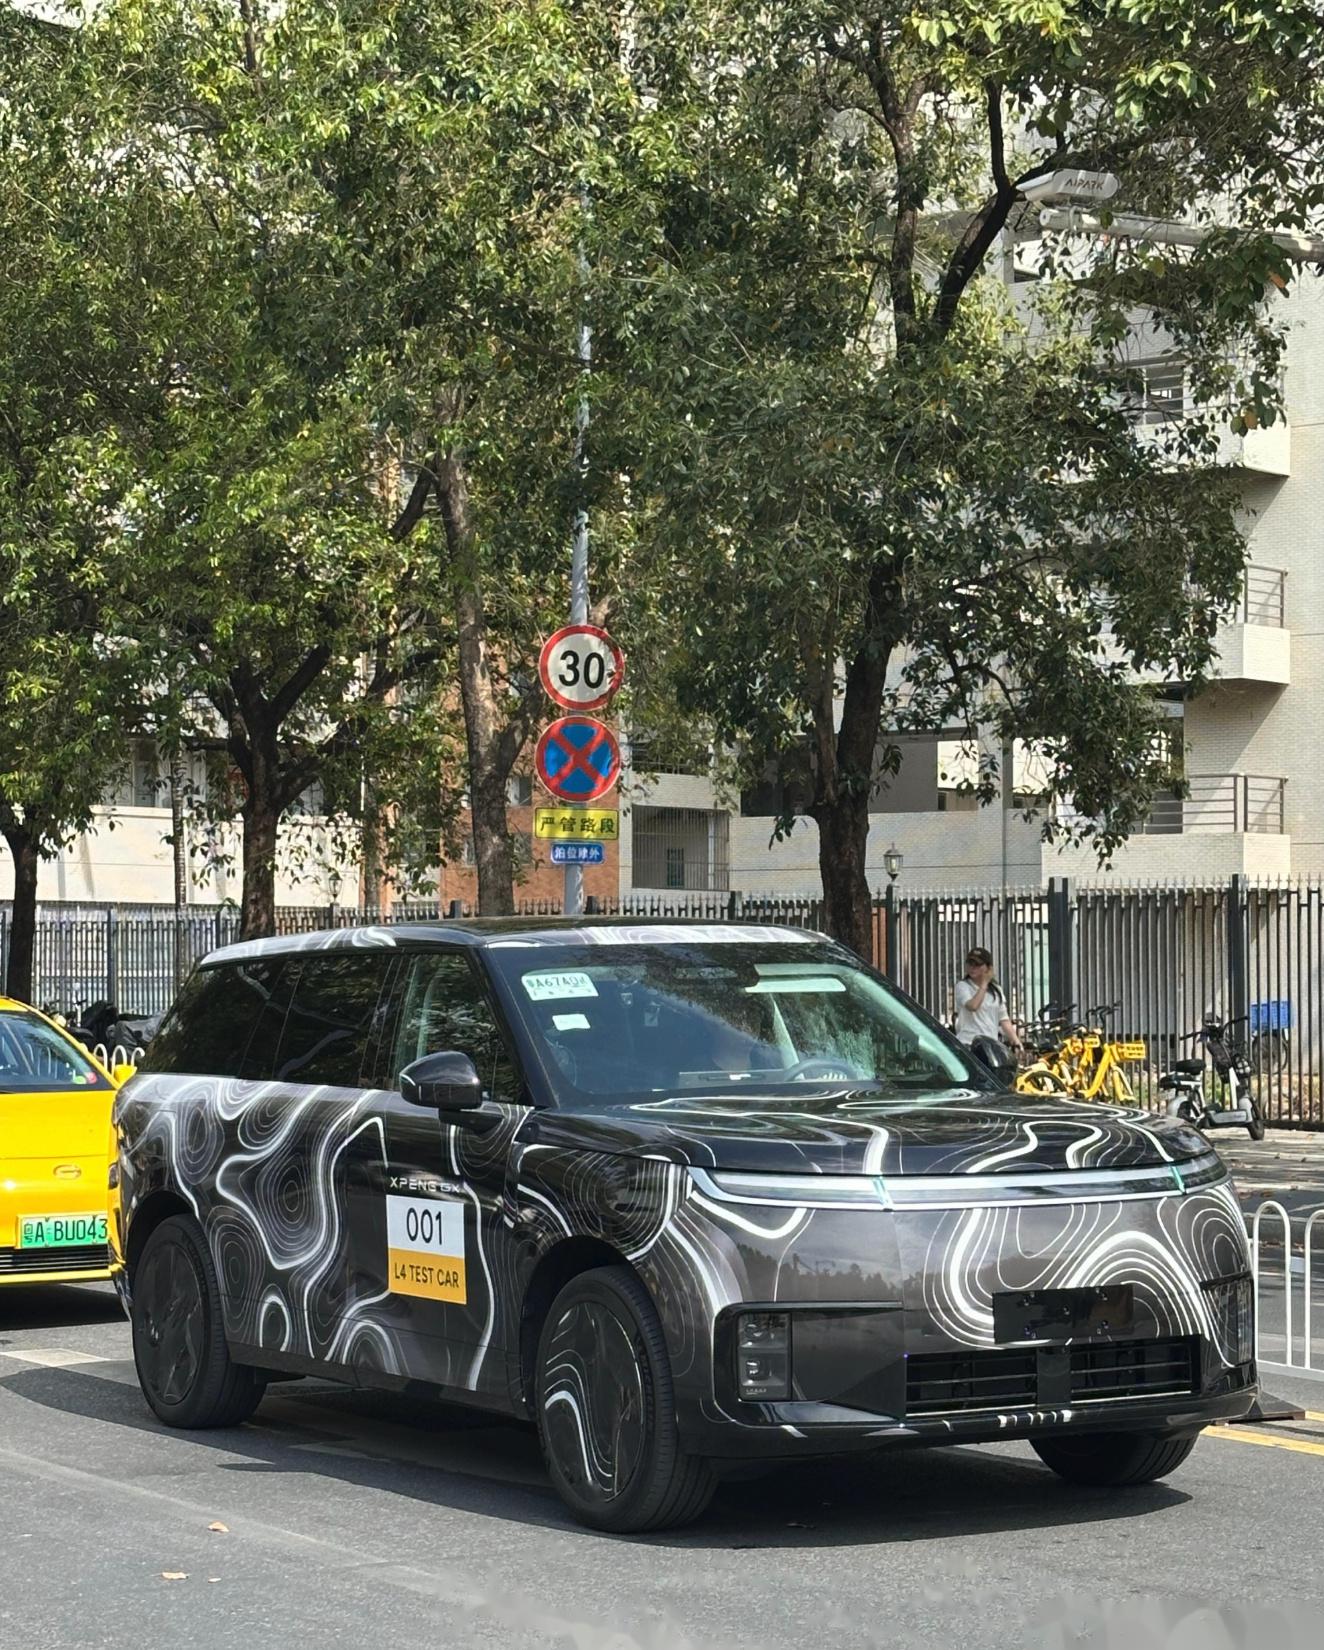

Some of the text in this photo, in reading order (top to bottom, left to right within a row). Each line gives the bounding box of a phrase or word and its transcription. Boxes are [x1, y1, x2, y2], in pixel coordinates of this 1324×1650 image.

[1065, 178, 1105, 191] AIPARK
[557, 649, 606, 689] 30
[540, 816, 616, 834] 严管路段
[389, 1176, 461, 1193] XPENG GX
[406, 1207, 443, 1246] 001
[394, 1262, 460, 1288] L4 TEST CAR
